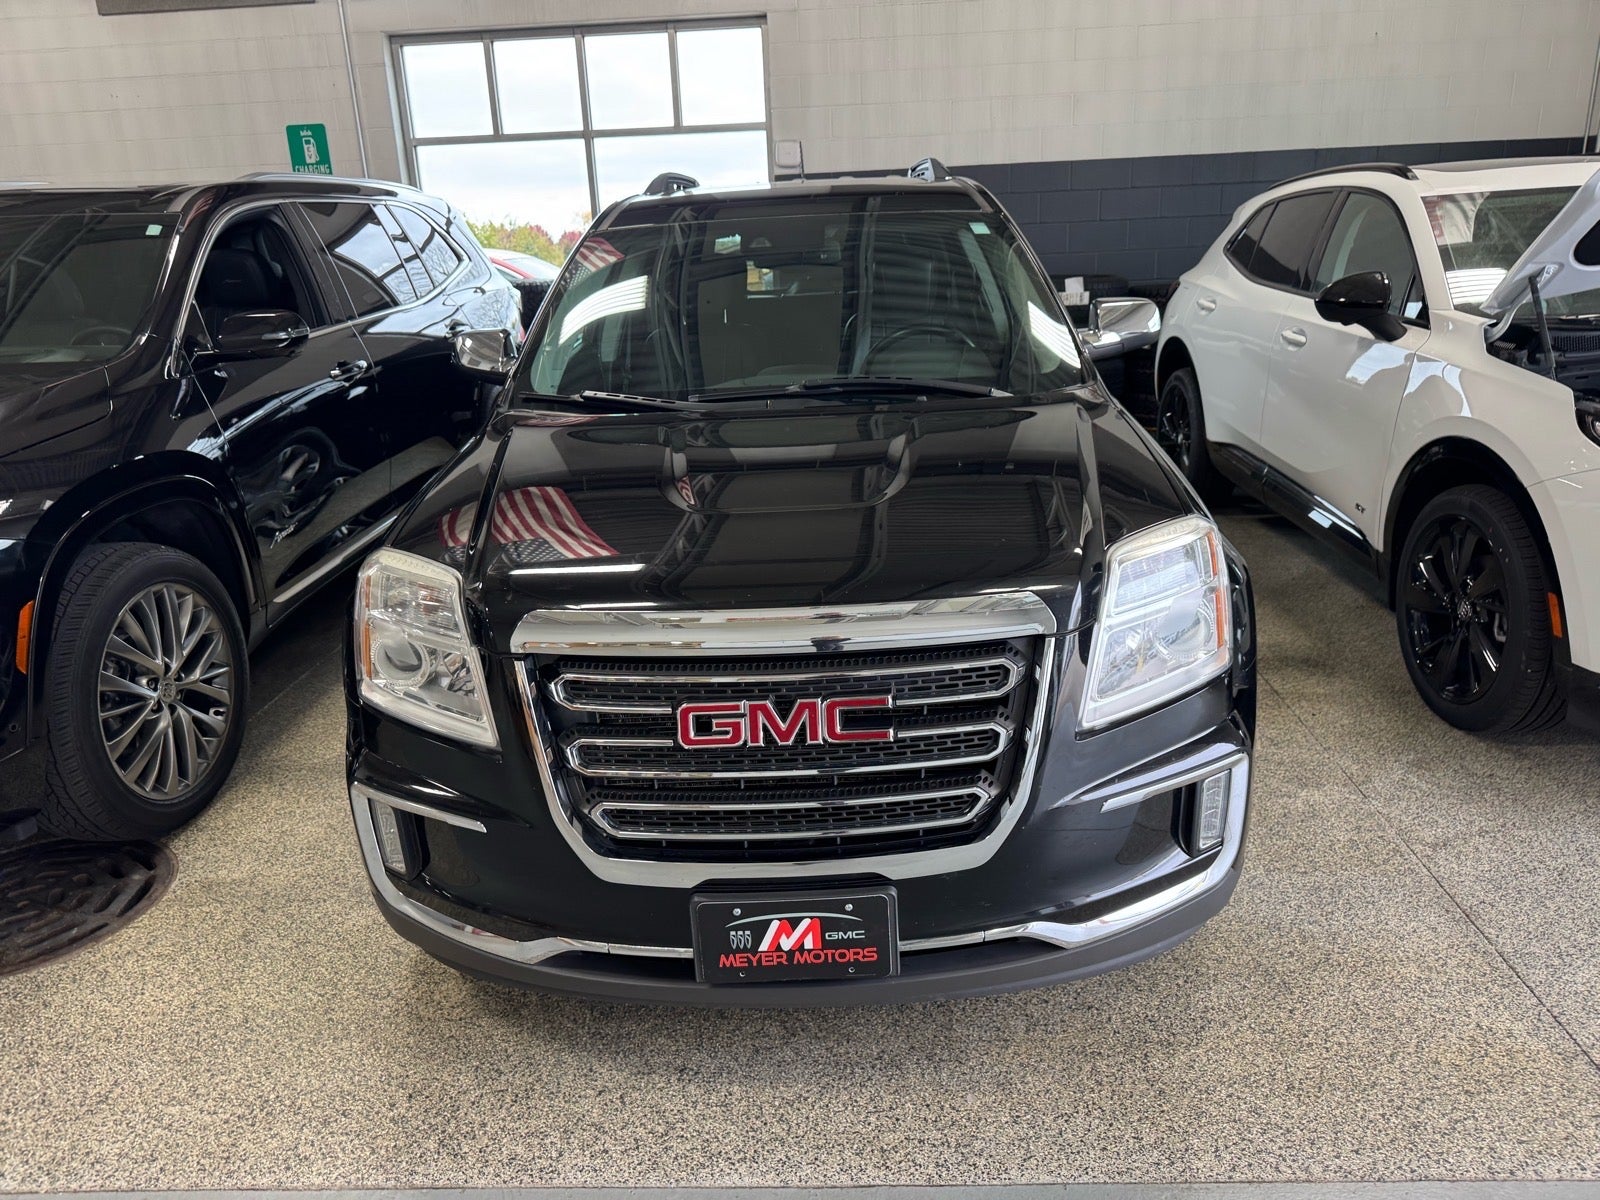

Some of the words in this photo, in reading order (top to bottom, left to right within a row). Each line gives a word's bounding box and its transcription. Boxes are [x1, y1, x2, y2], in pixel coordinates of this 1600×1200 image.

[295, 164, 330, 174] CHARGING
[678, 694, 894, 749] GMC
[825, 930, 866, 940] GMC
[719, 951, 789, 968] MEYER
[793, 947, 878, 965] MOTORS
